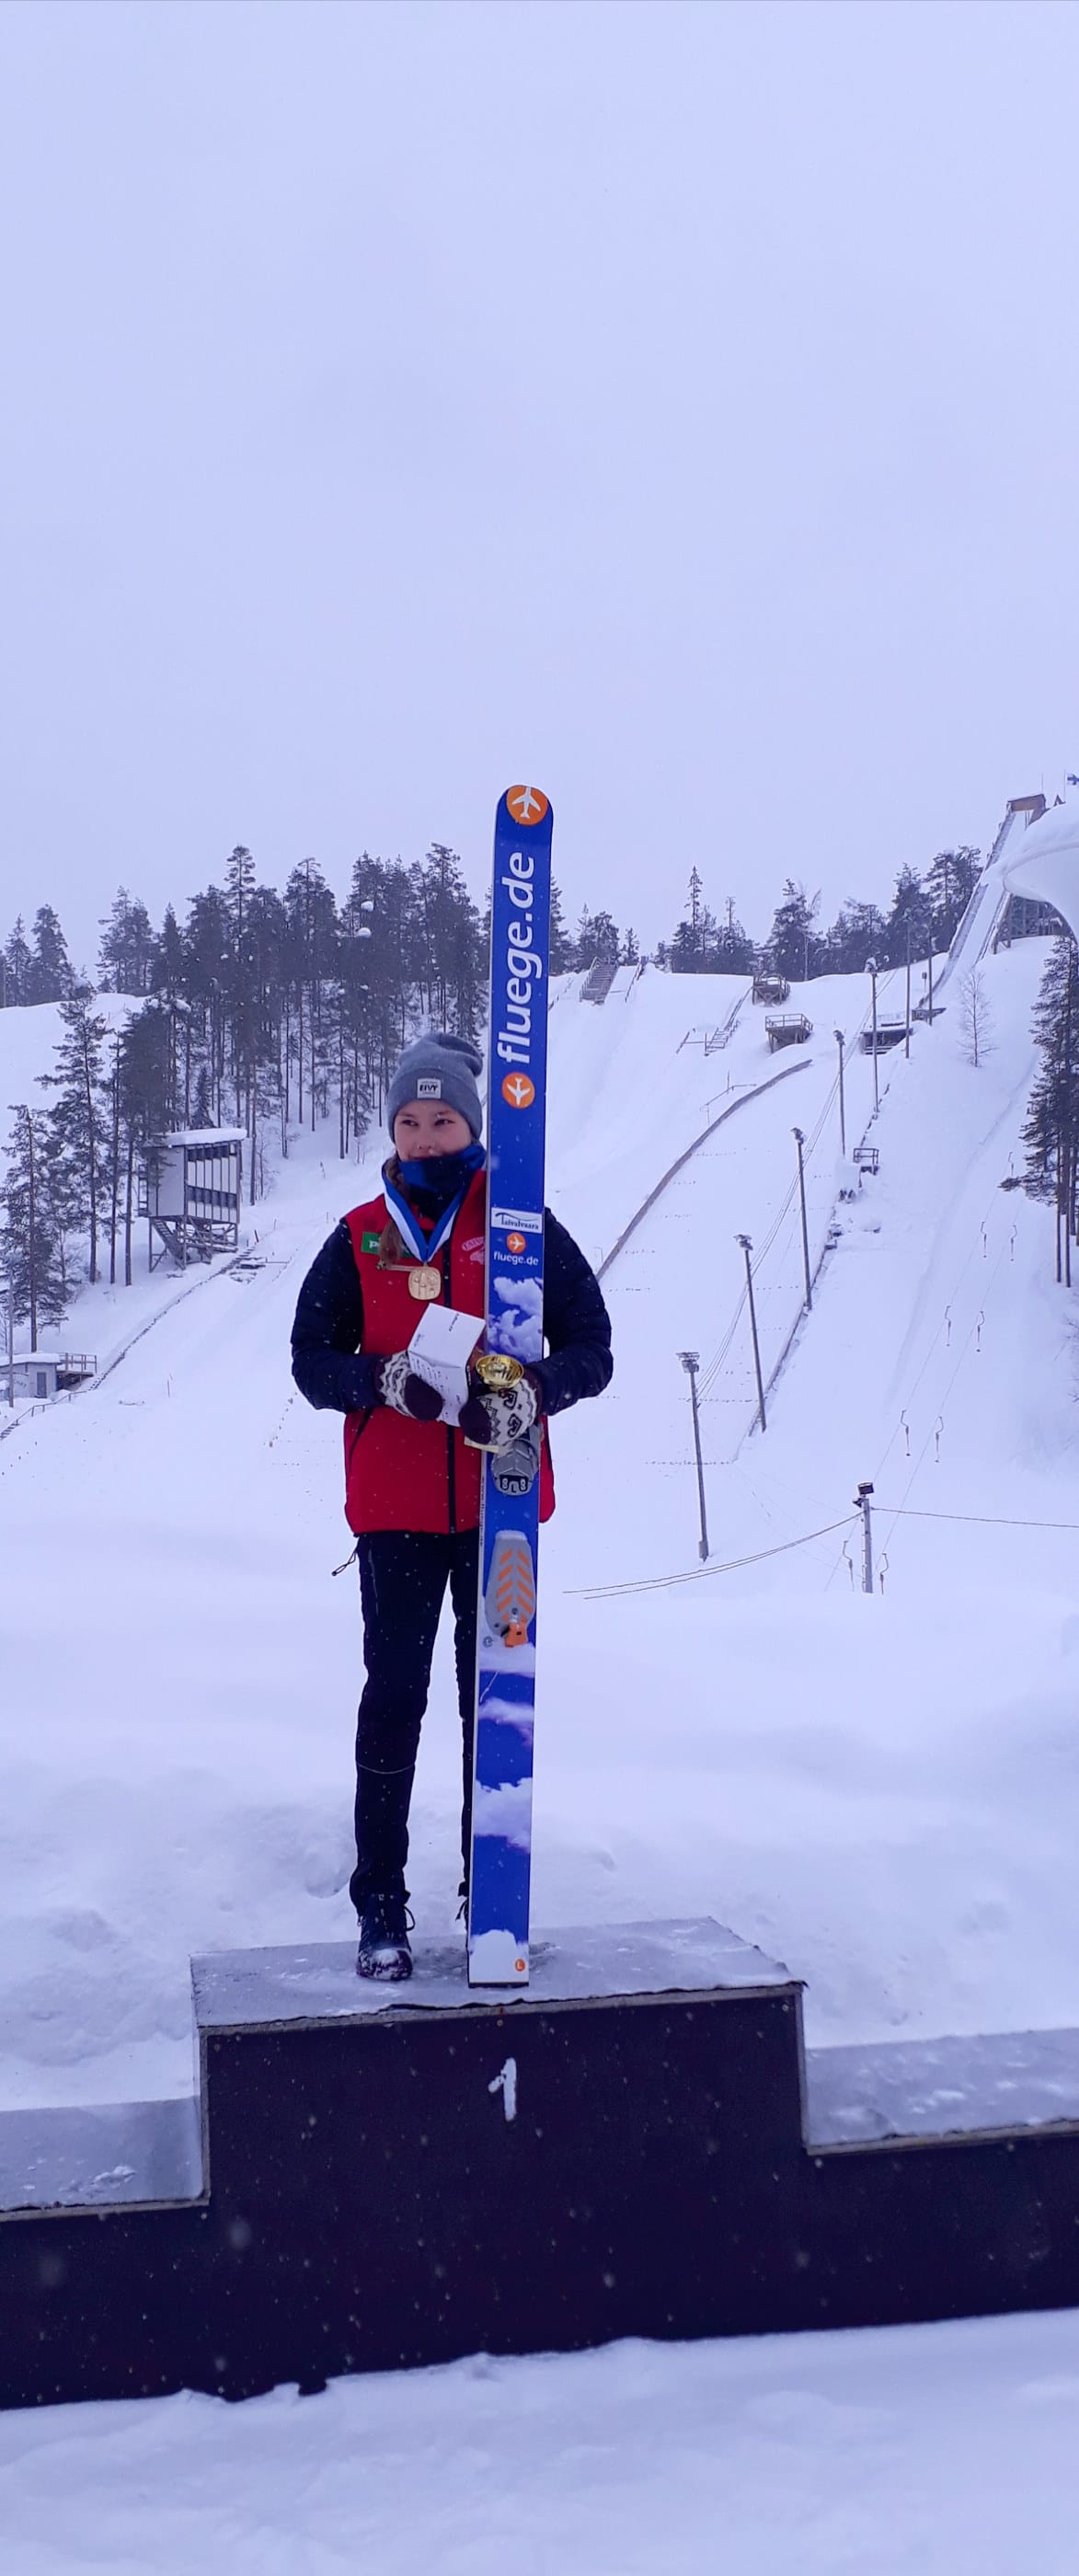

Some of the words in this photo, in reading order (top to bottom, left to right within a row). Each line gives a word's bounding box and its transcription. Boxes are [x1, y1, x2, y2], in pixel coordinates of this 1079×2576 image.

[497, 852, 542, 1064] fluege.de
[495, 1212, 539, 1230] Taivalvaara
[493, 1250, 539, 1266] fluege.de
[516, 1960, 523, 1970] L
[488, 2057, 517, 2122] 1
